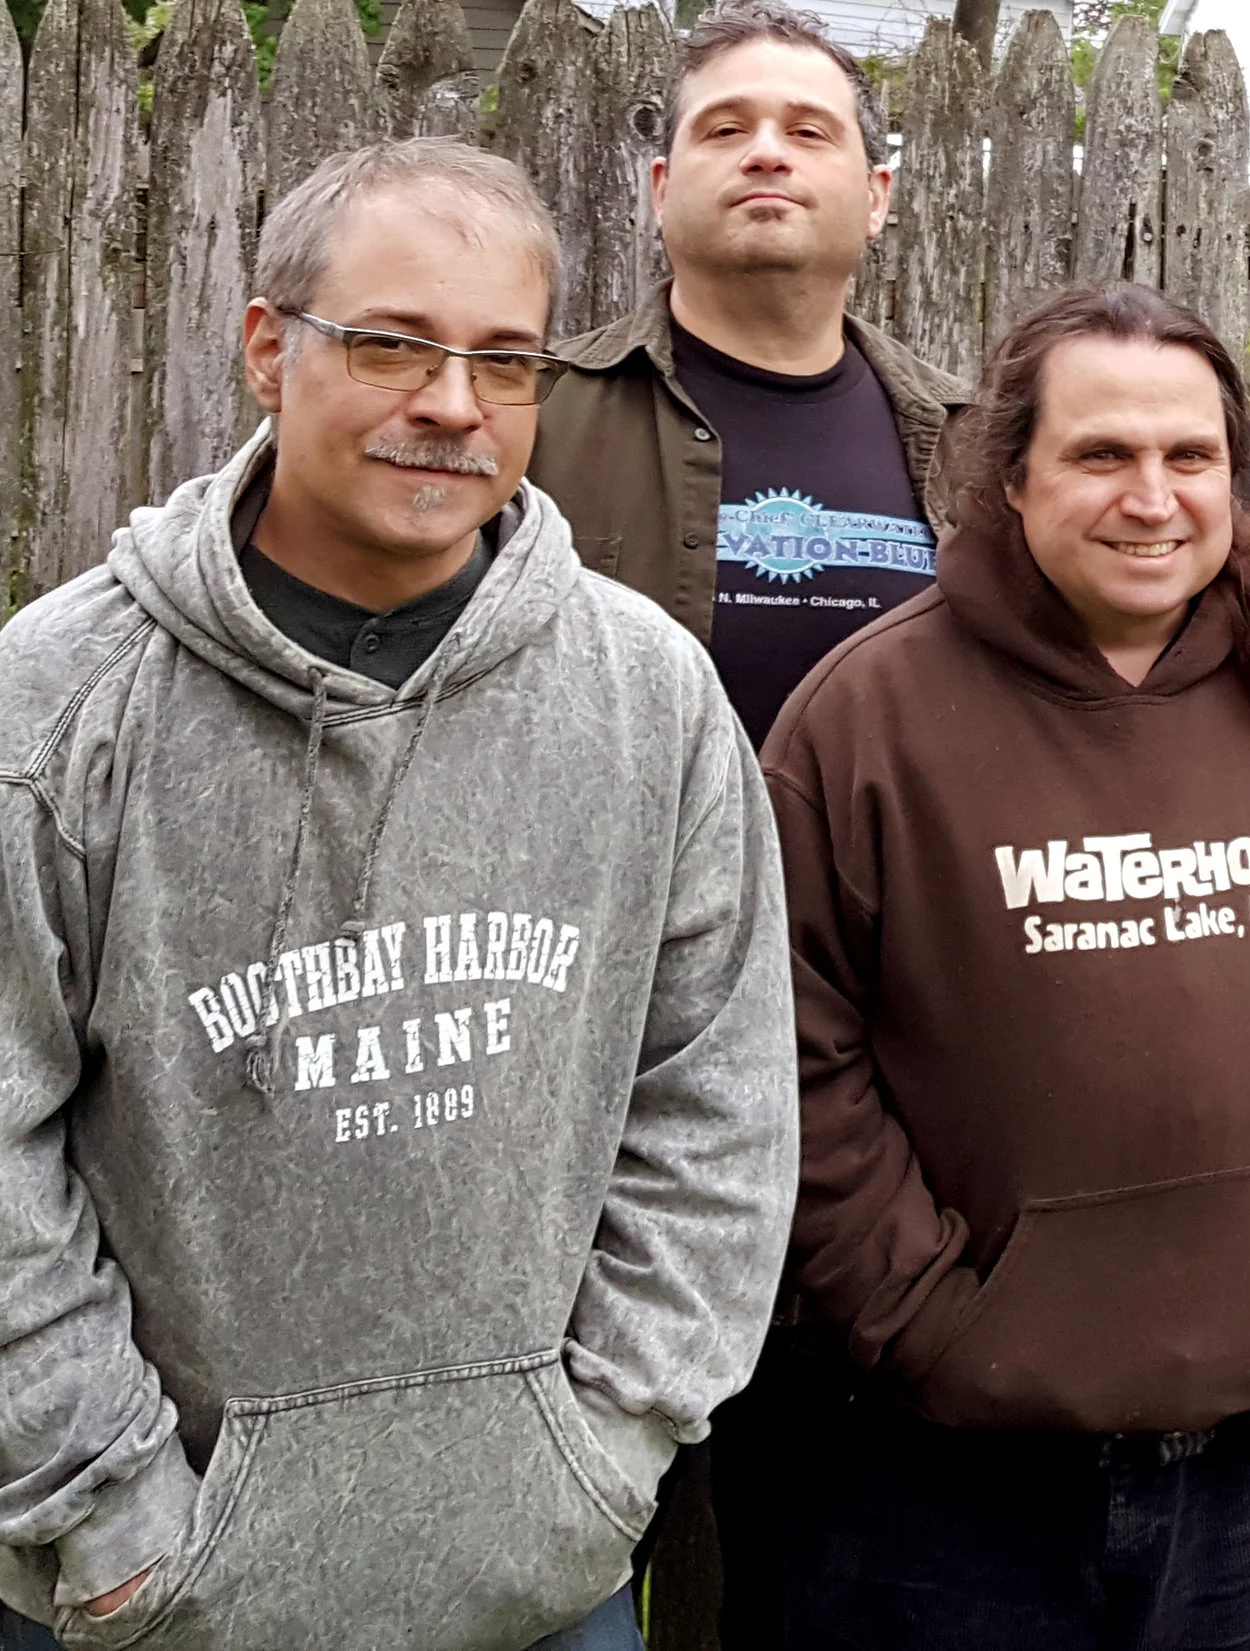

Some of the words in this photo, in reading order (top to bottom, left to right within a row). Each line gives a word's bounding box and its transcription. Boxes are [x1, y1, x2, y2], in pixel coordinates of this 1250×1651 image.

[718, 592, 732, 604] N.
[735, 593, 800, 606] Milwaukee
[810, 596, 866, 610] Chicago,
[868, 598, 881, 609] IL
[1024, 915, 1156, 954] Saranac
[1164, 903, 1244, 941] Lake,
[187, 921, 406, 1053] BOOTHBAY
[423, 911, 580, 993] HARBOR
[294, 997, 512, 1091] MAINE
[335, 1101, 398, 1143] EST.
[413, 1084, 475, 1129] 1889
